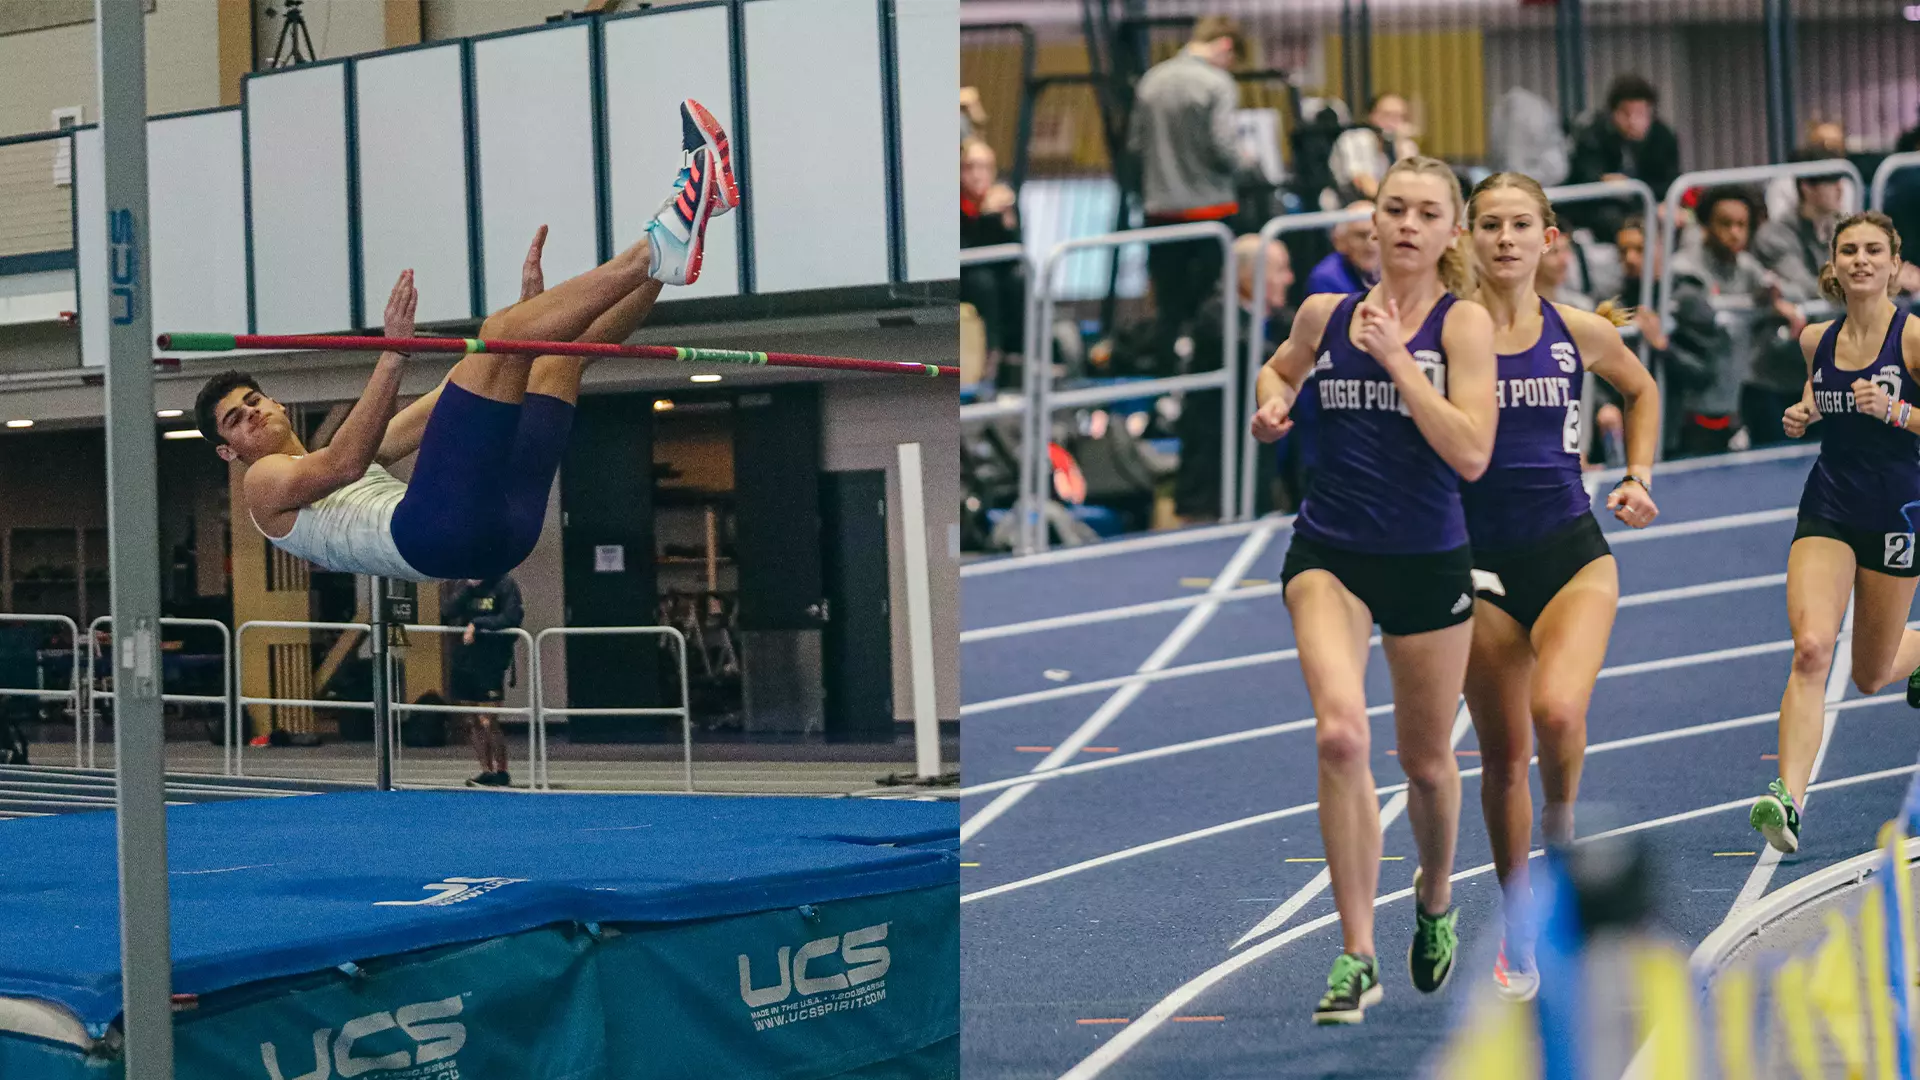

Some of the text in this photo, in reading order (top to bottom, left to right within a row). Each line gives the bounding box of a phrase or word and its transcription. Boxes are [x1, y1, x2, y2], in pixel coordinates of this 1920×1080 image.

[110, 208, 134, 325] UCS
[1319, 378, 1404, 412] HIGH POI
[1509, 377, 1571, 408] POINT
[1887, 534, 1910, 566] 2
[738, 922, 892, 1008] UCS
[750, 1008, 770, 1019] MADE
[770, 1006, 780, 1014] IN
[781, 1002, 799, 1012] THE
[753, 988, 887, 1032] WWW.UCSSPIRIT.COM
[260, 995, 467, 1080] UCS
